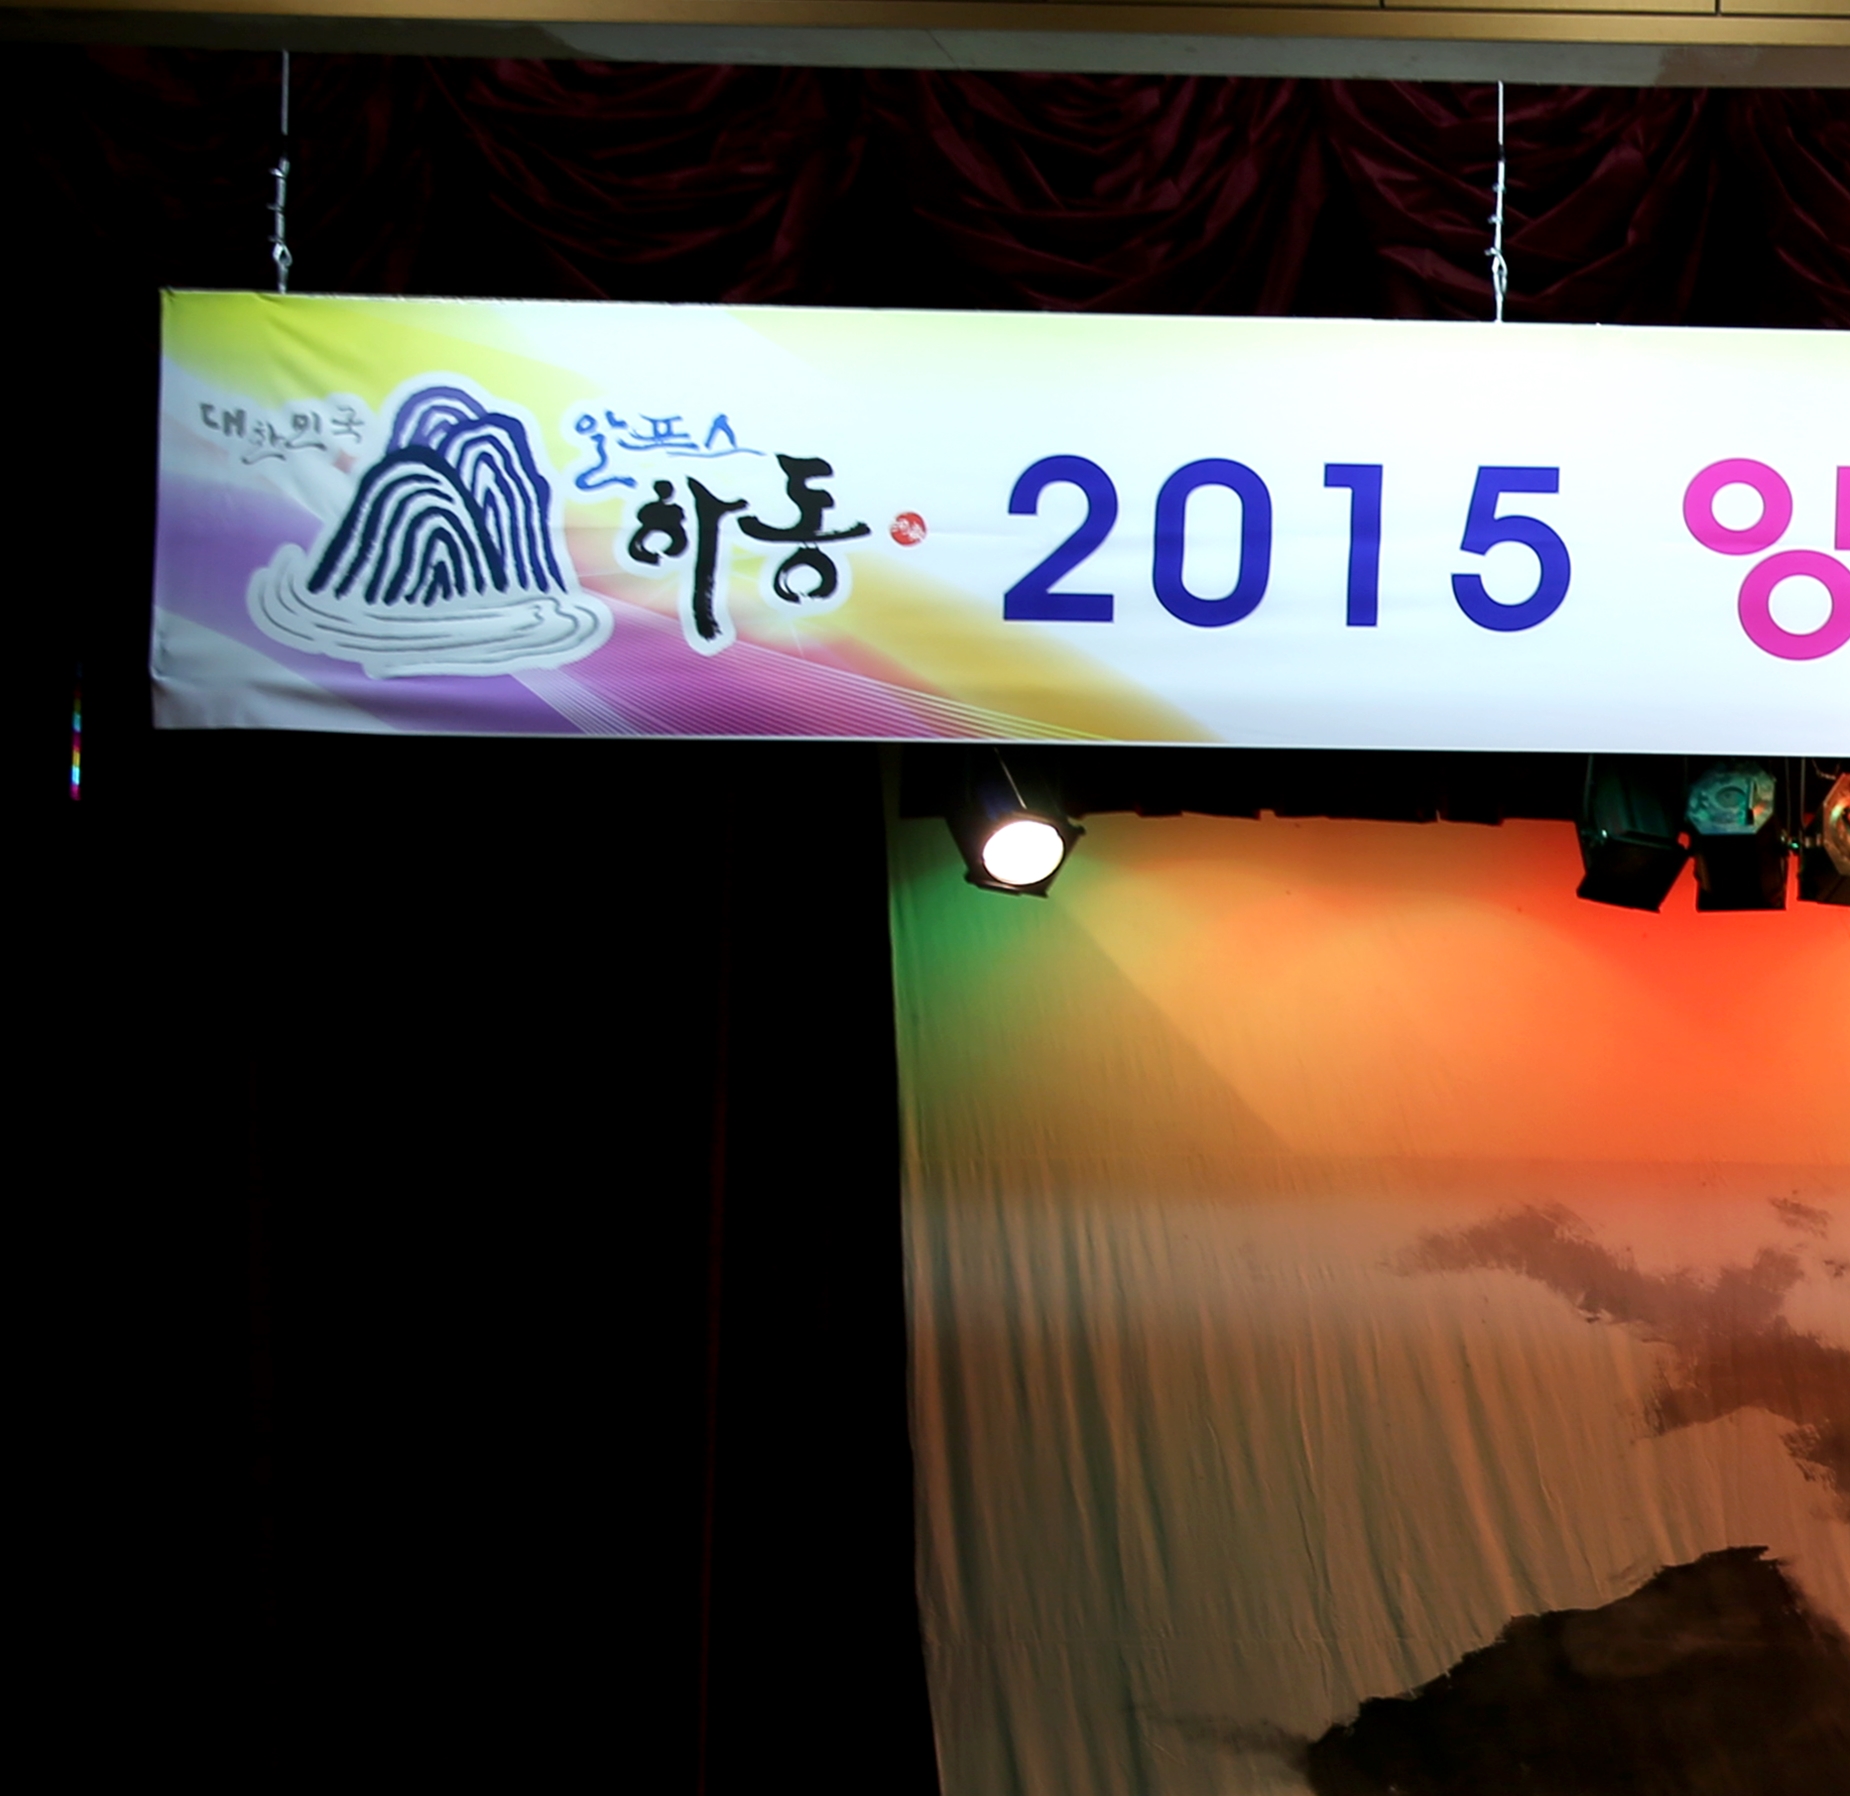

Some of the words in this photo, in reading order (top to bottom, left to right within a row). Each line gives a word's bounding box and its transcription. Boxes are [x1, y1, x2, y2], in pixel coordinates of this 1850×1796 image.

[199, 402, 365, 465] 대한민국
[574, 409, 768, 491] 알프스
[627, 453, 871, 641] 하동
[1003, 454, 1572, 632] 2015
